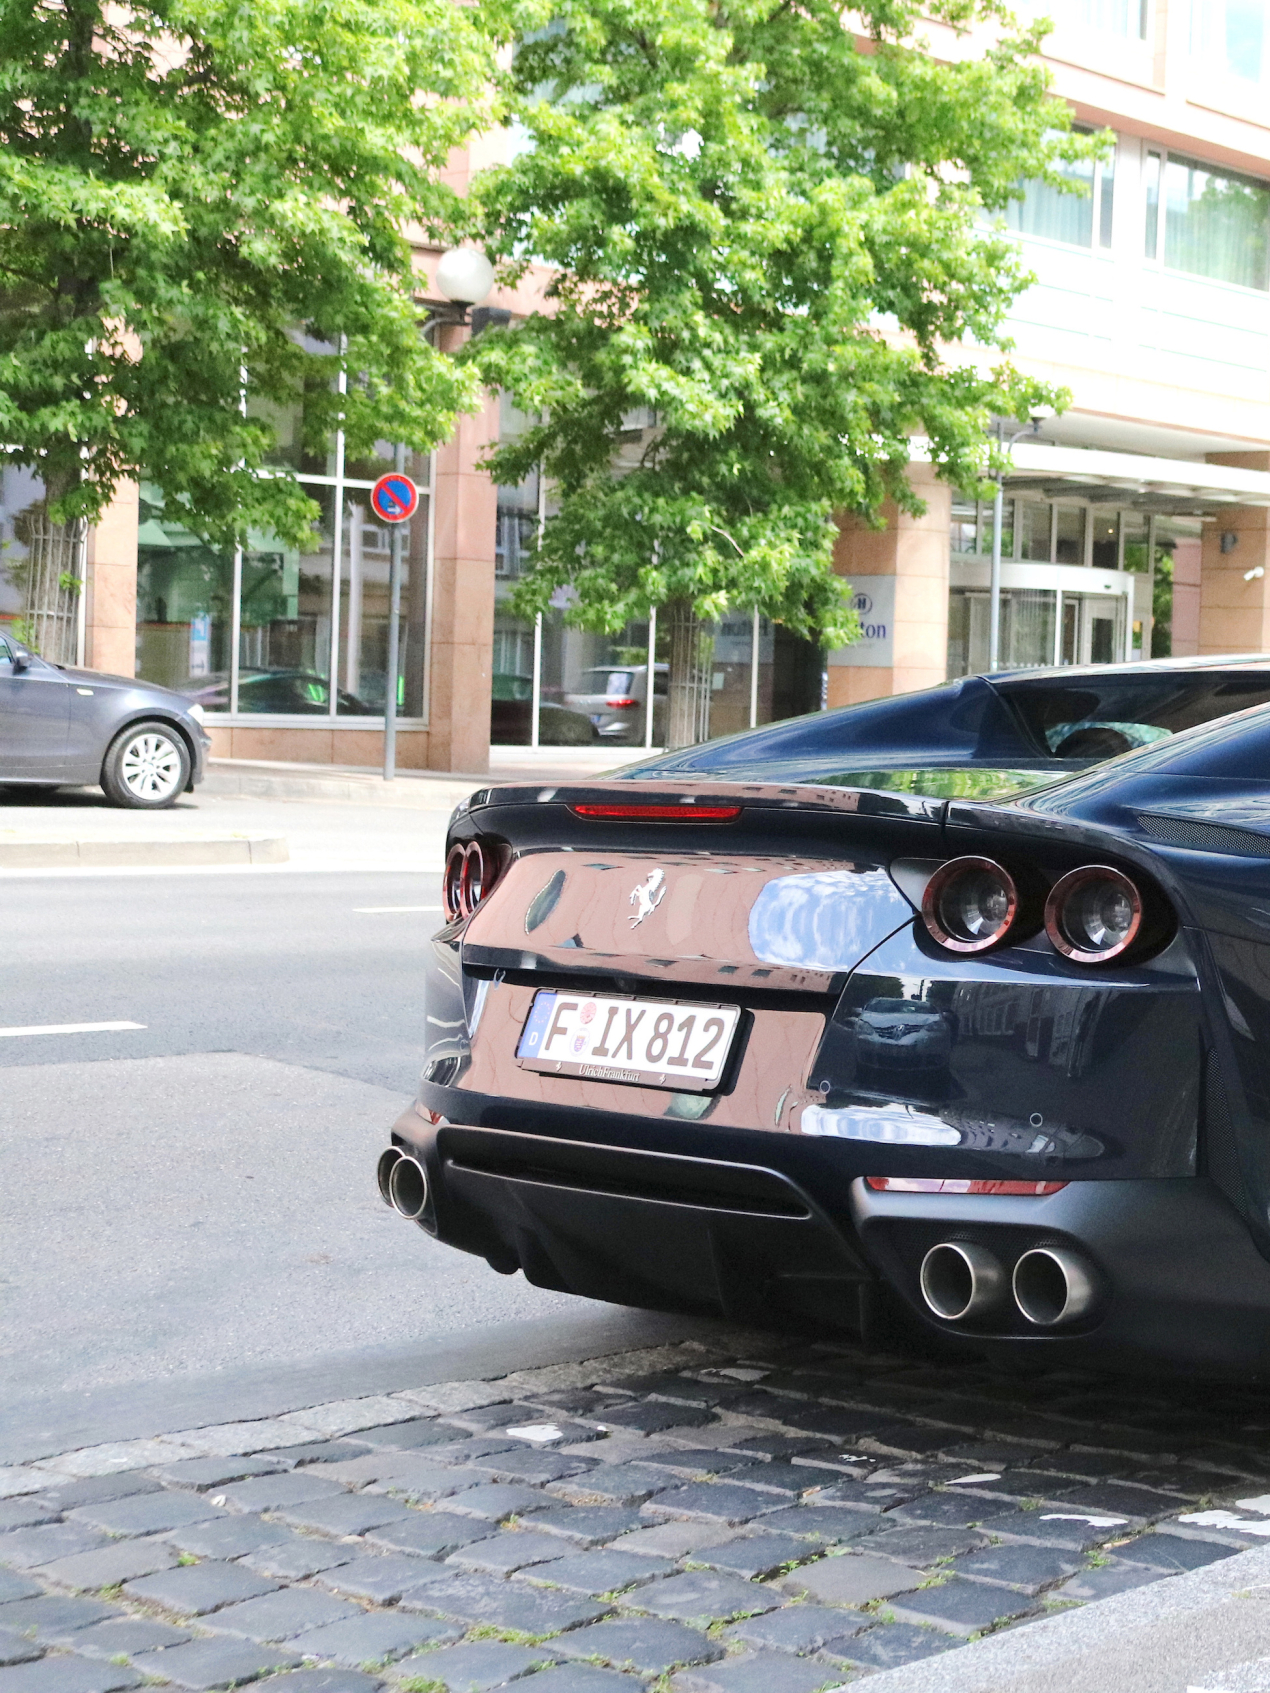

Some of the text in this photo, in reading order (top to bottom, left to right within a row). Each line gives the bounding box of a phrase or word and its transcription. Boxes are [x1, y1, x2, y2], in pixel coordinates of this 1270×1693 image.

[528, 1031, 539, 1047] D
[544, 1002, 726, 1071] F IX 812
